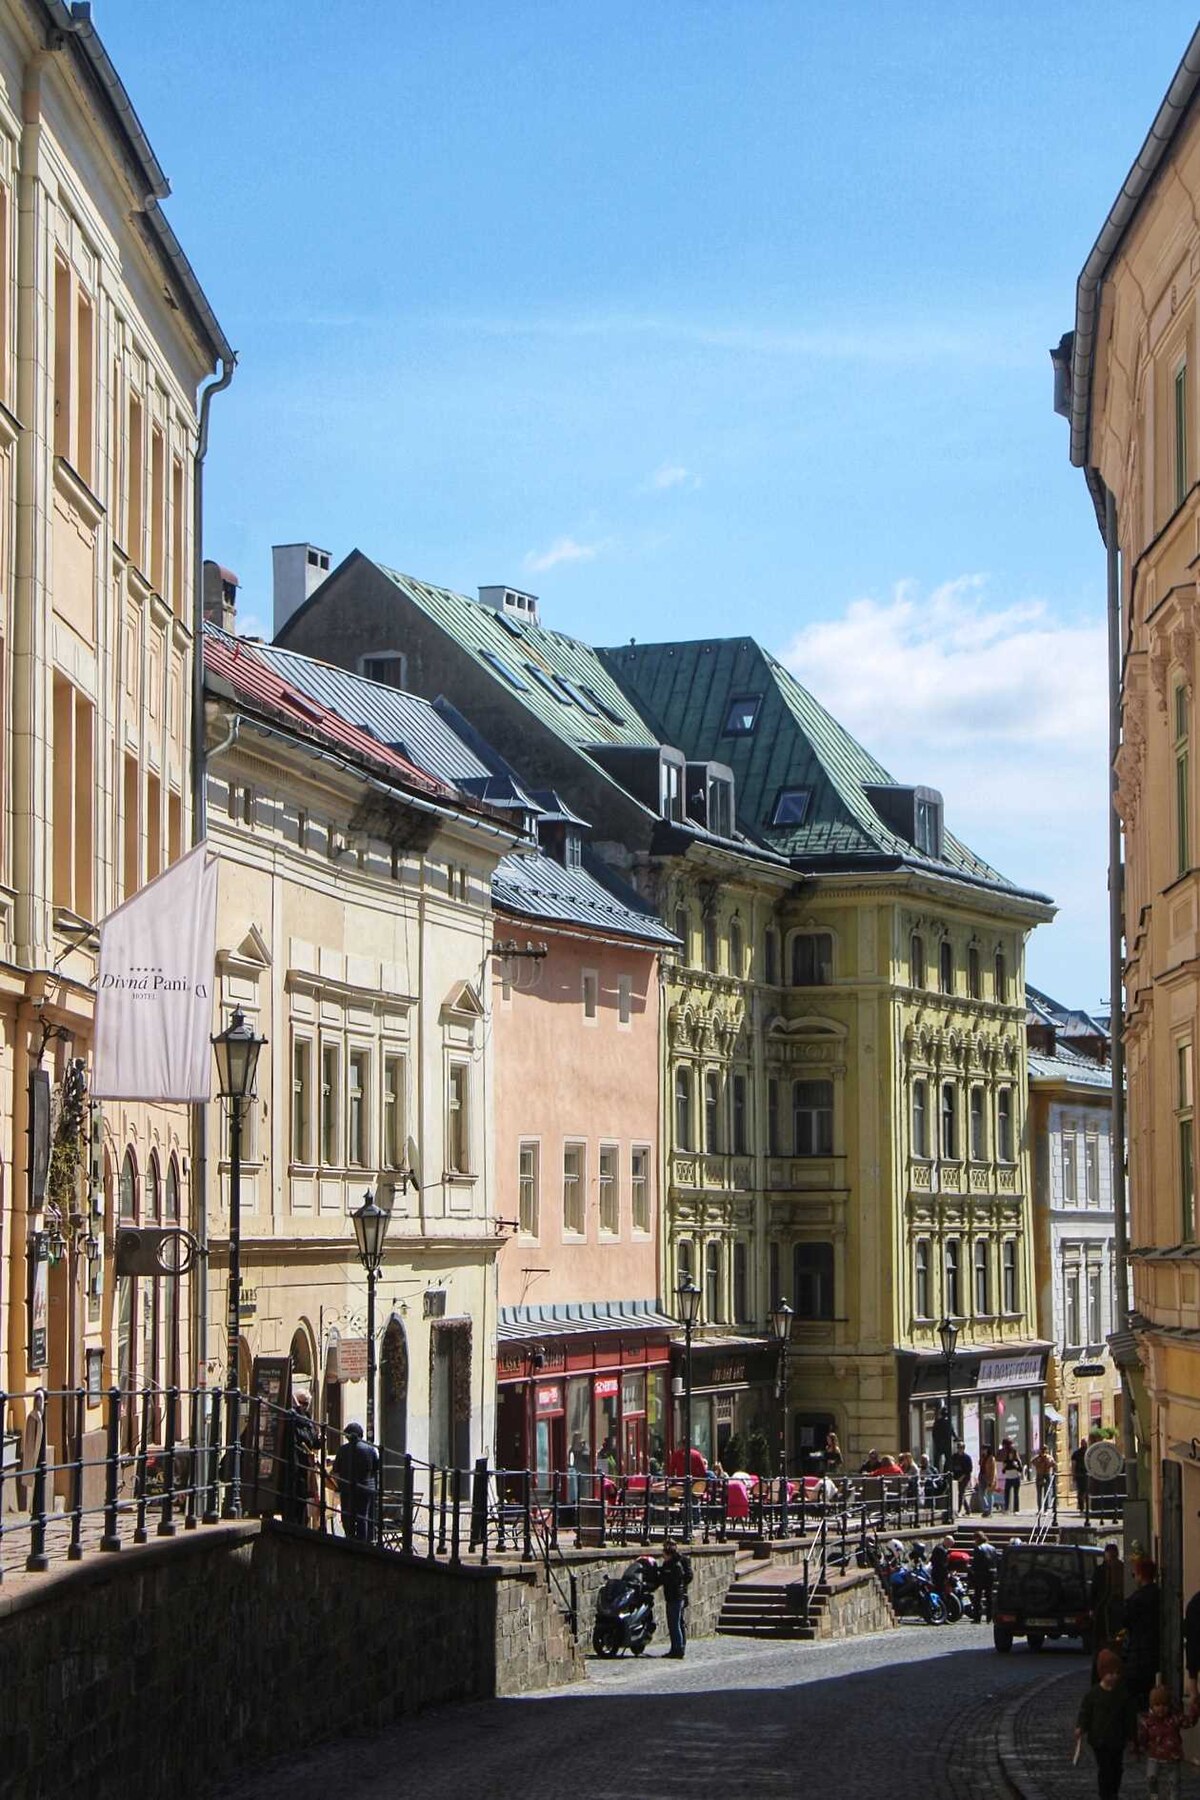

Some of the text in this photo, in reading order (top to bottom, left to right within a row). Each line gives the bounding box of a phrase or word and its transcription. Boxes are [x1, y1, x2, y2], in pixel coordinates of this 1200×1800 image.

[101, 974, 149, 989] Divná
[153, 975, 187, 991] Pani
[131, 992, 157, 1000] HOTEL
